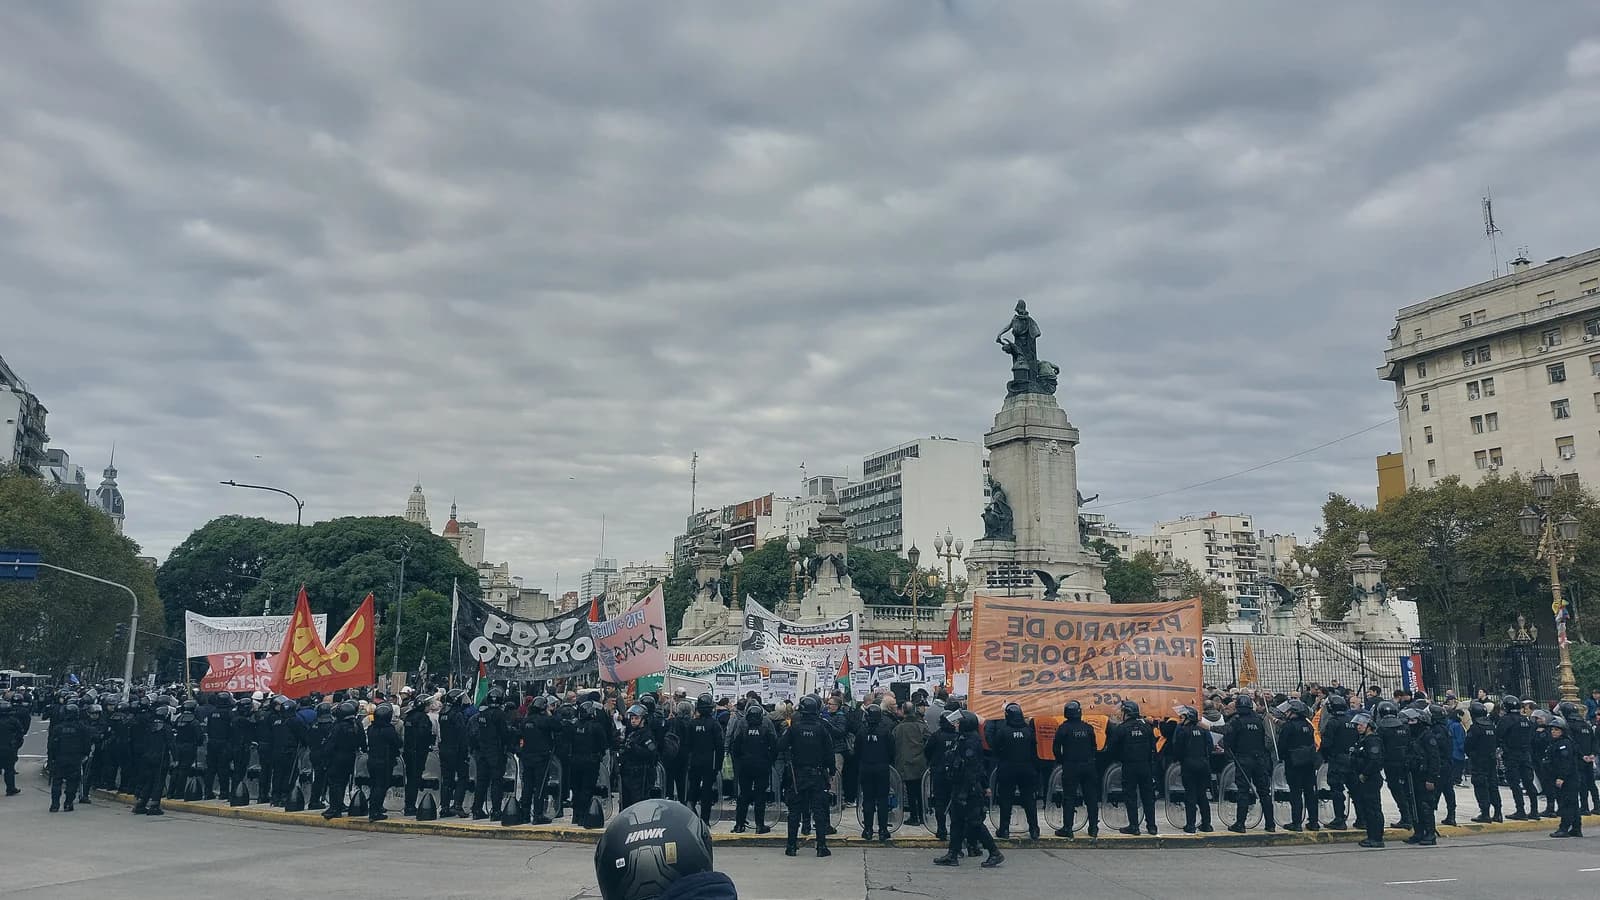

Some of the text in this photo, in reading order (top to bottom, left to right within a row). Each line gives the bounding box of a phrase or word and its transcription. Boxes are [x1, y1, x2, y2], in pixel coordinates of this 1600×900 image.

[783, 633, 851, 647] de izquierda
[469, 636, 594, 667] OBRERO
[858, 644, 933, 666] RENTE
[781, 656, 805, 666] ANCLA
[624, 827, 667, 845] HAWK
